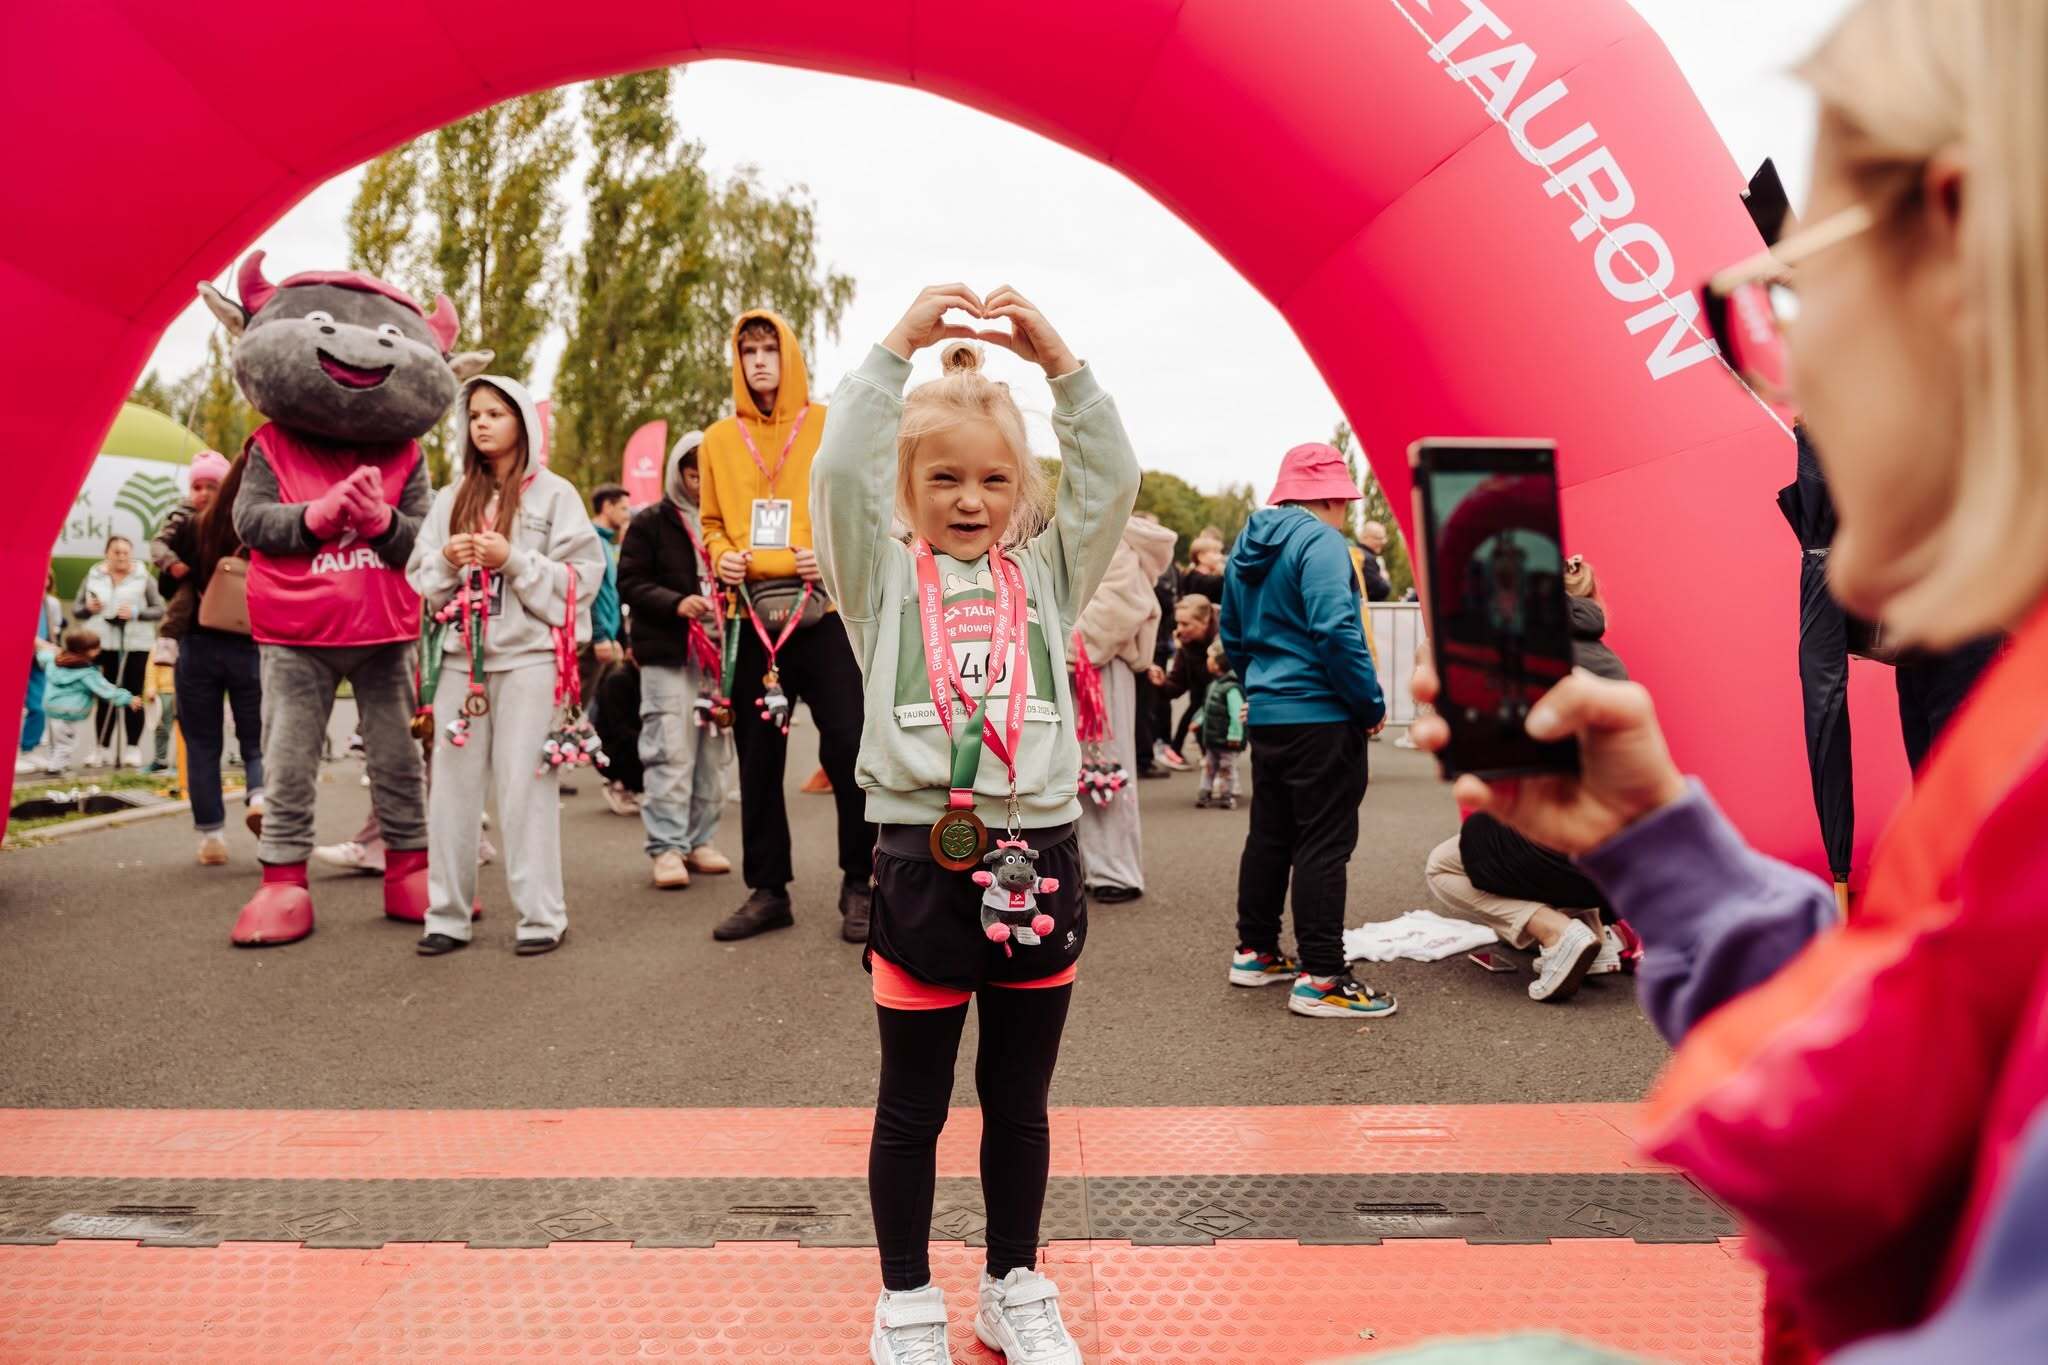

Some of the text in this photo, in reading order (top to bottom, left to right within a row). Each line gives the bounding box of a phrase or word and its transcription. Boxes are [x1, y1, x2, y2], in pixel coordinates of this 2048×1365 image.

[1427, 0, 1721, 381] TAURON
[311, 547, 389, 575] TAUR
[962, 605, 995, 617] TAUR
[928, 614, 940, 647] Nowej
[959, 622, 992, 635] Nowej
[932, 647, 943, 671] Bieg
[903, 709, 936, 719] TAURON
[935, 677, 952, 727] TAURON
[1013, 693, 1022, 720] TAURON
